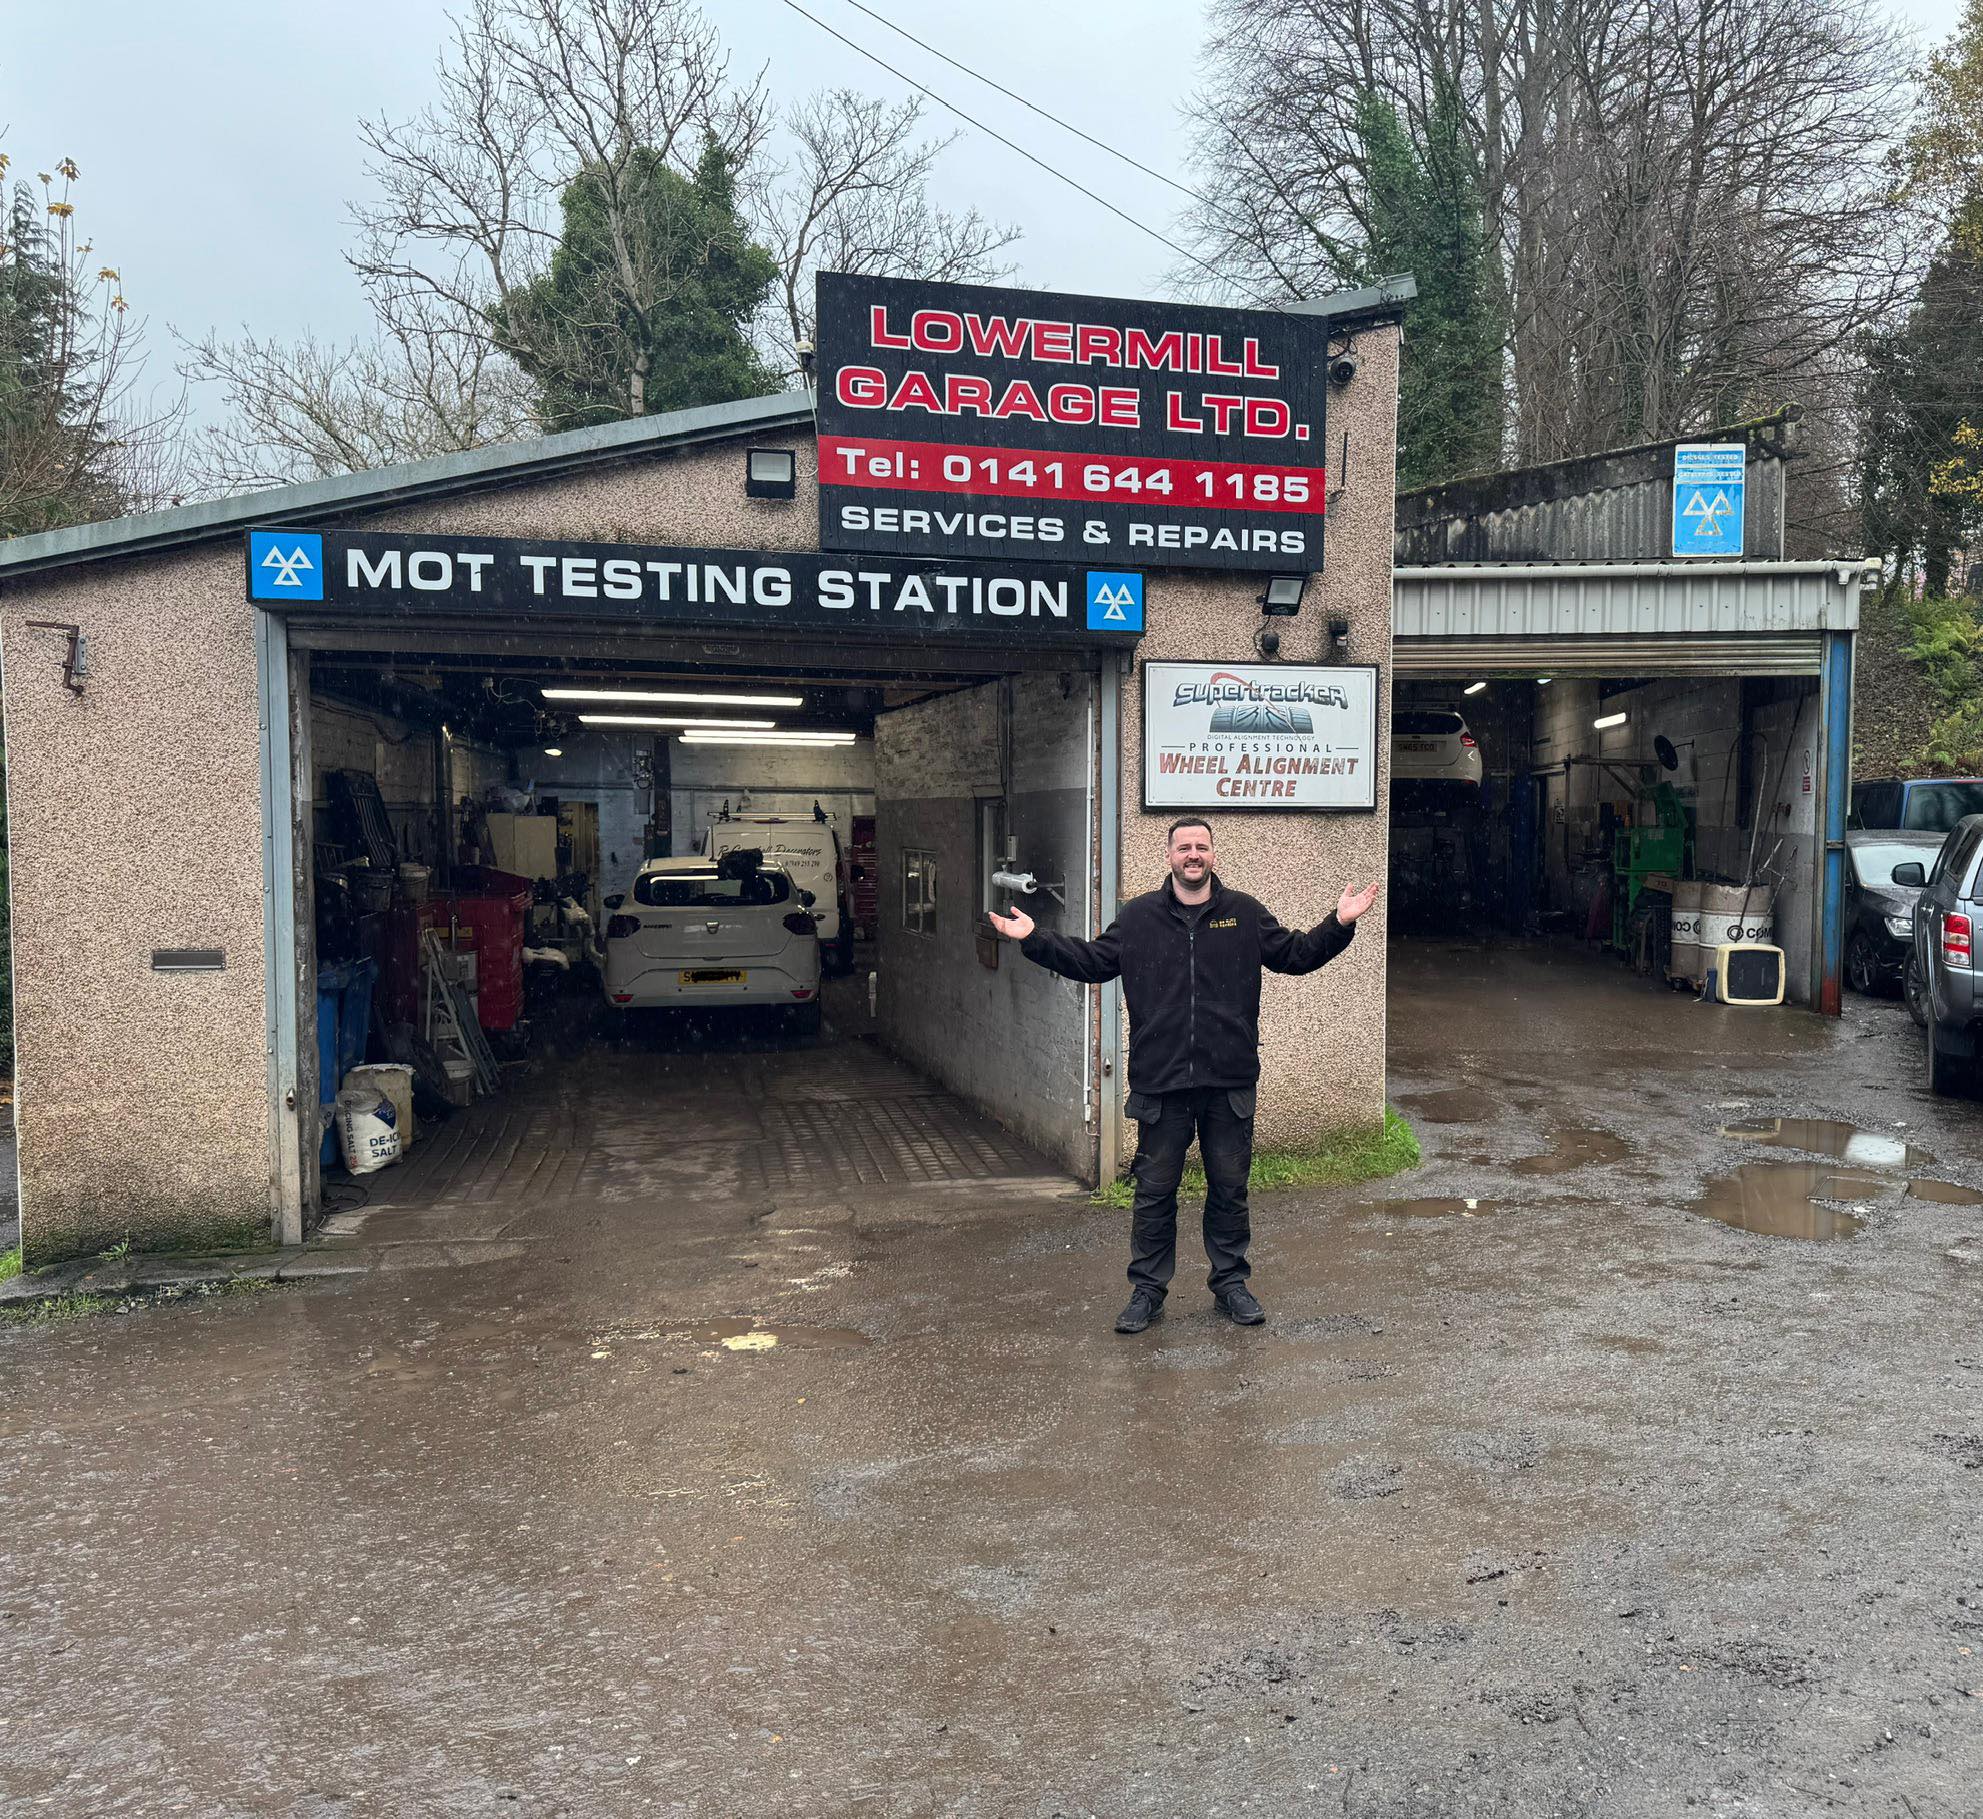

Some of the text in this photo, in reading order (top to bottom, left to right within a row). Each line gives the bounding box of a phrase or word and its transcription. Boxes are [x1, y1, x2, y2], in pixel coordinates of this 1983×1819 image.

[870, 304, 1280, 381] LOWERMILL
[835, 365, 1310, 441] GARAGE LTD.
[837, 446, 1310, 504] Tel: 0141 644 1185
[841, 506, 1305, 554] SERVICES & REPAIRS
[346, 548, 1070, 618] MOT TESTING STATION
[1189, 742, 1333, 753] PROFESSIONAL
[1273, 734, 1316, 742] TECHNOLOGY
[1159, 752, 1359, 776] WHEEL ALIGNMENT
[1216, 777, 1298, 798] CENTRE
[1673, 921, 1691, 933] CO
[346, 1134, 356, 1154] SALT
[371, 1145, 396, 1158] SALT
